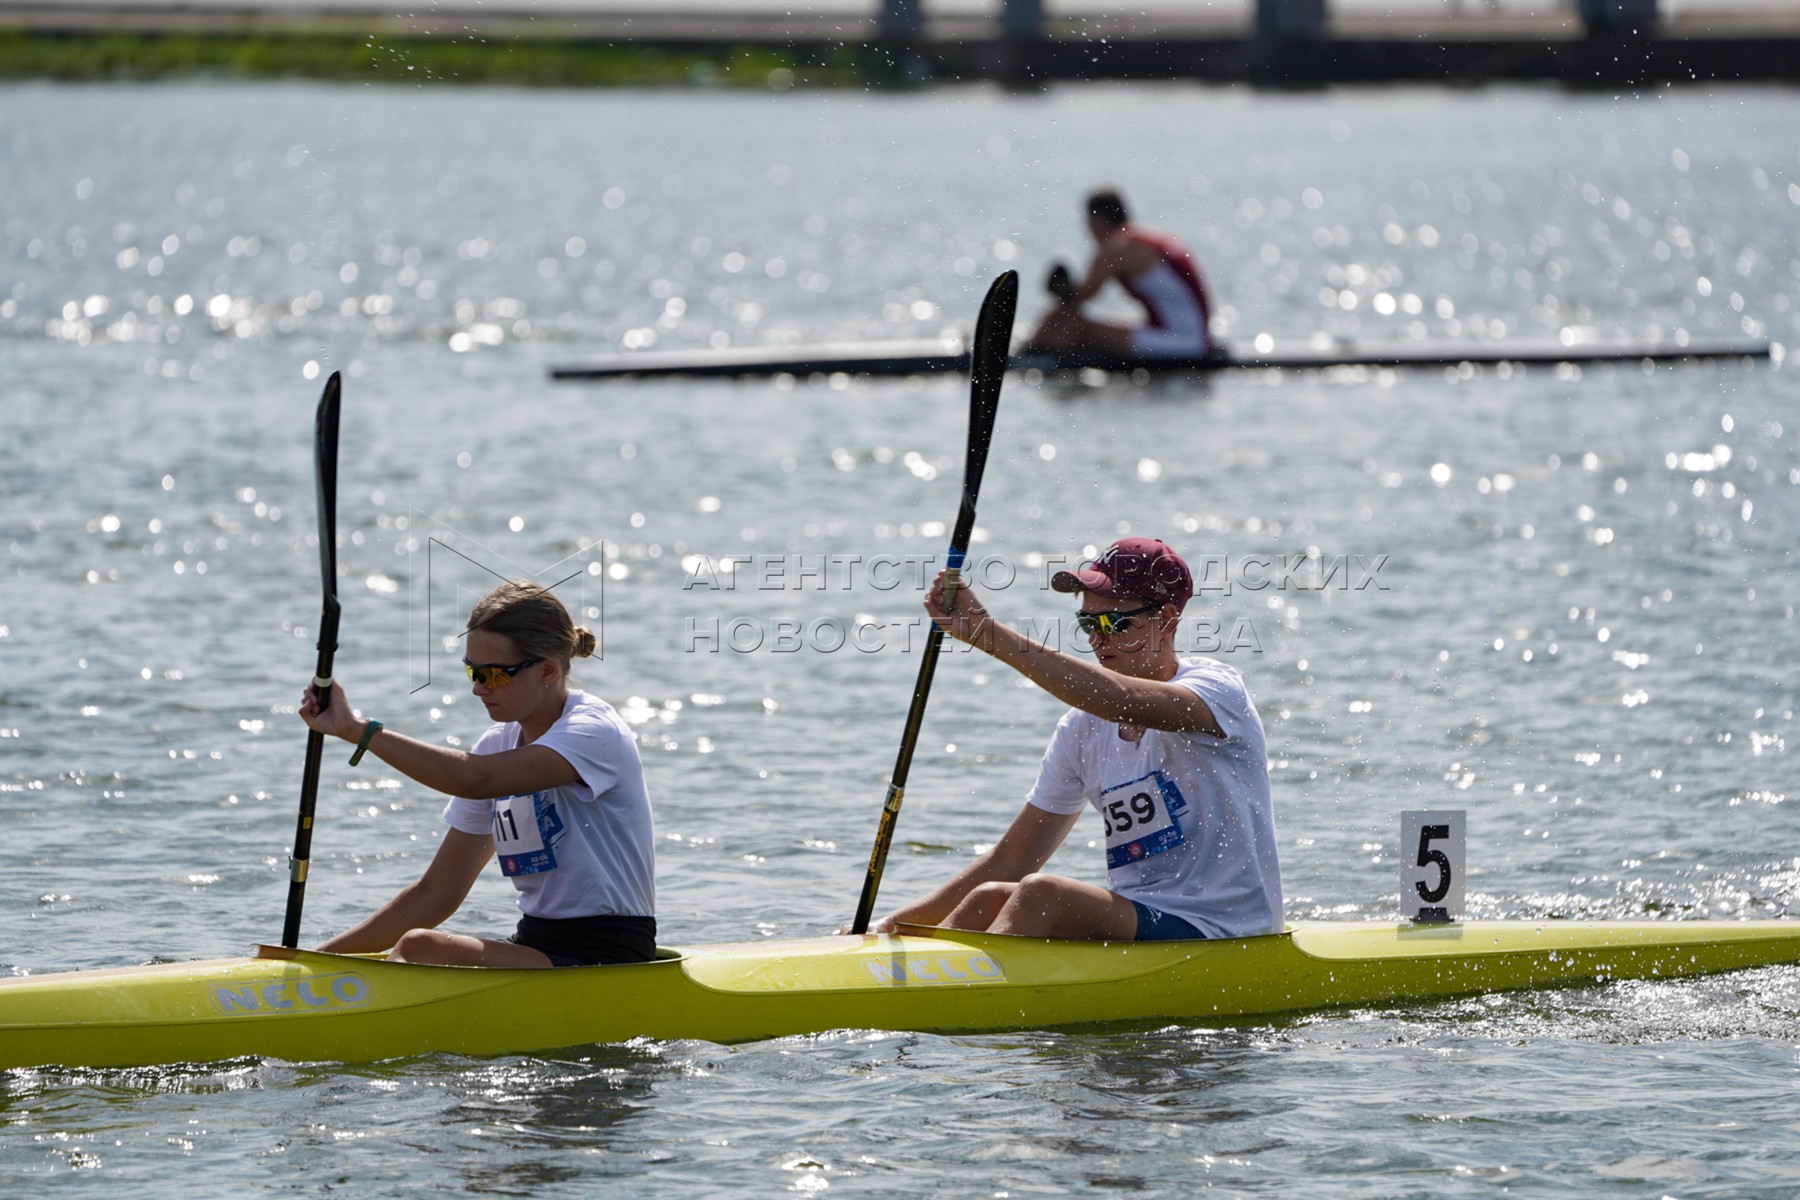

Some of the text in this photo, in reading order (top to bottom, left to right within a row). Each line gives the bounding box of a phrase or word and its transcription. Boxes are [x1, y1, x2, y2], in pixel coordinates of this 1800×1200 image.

[1415, 824, 1451, 903] 5
[866, 956, 1001, 982] NELO
[215, 976, 367, 1012] NELO
